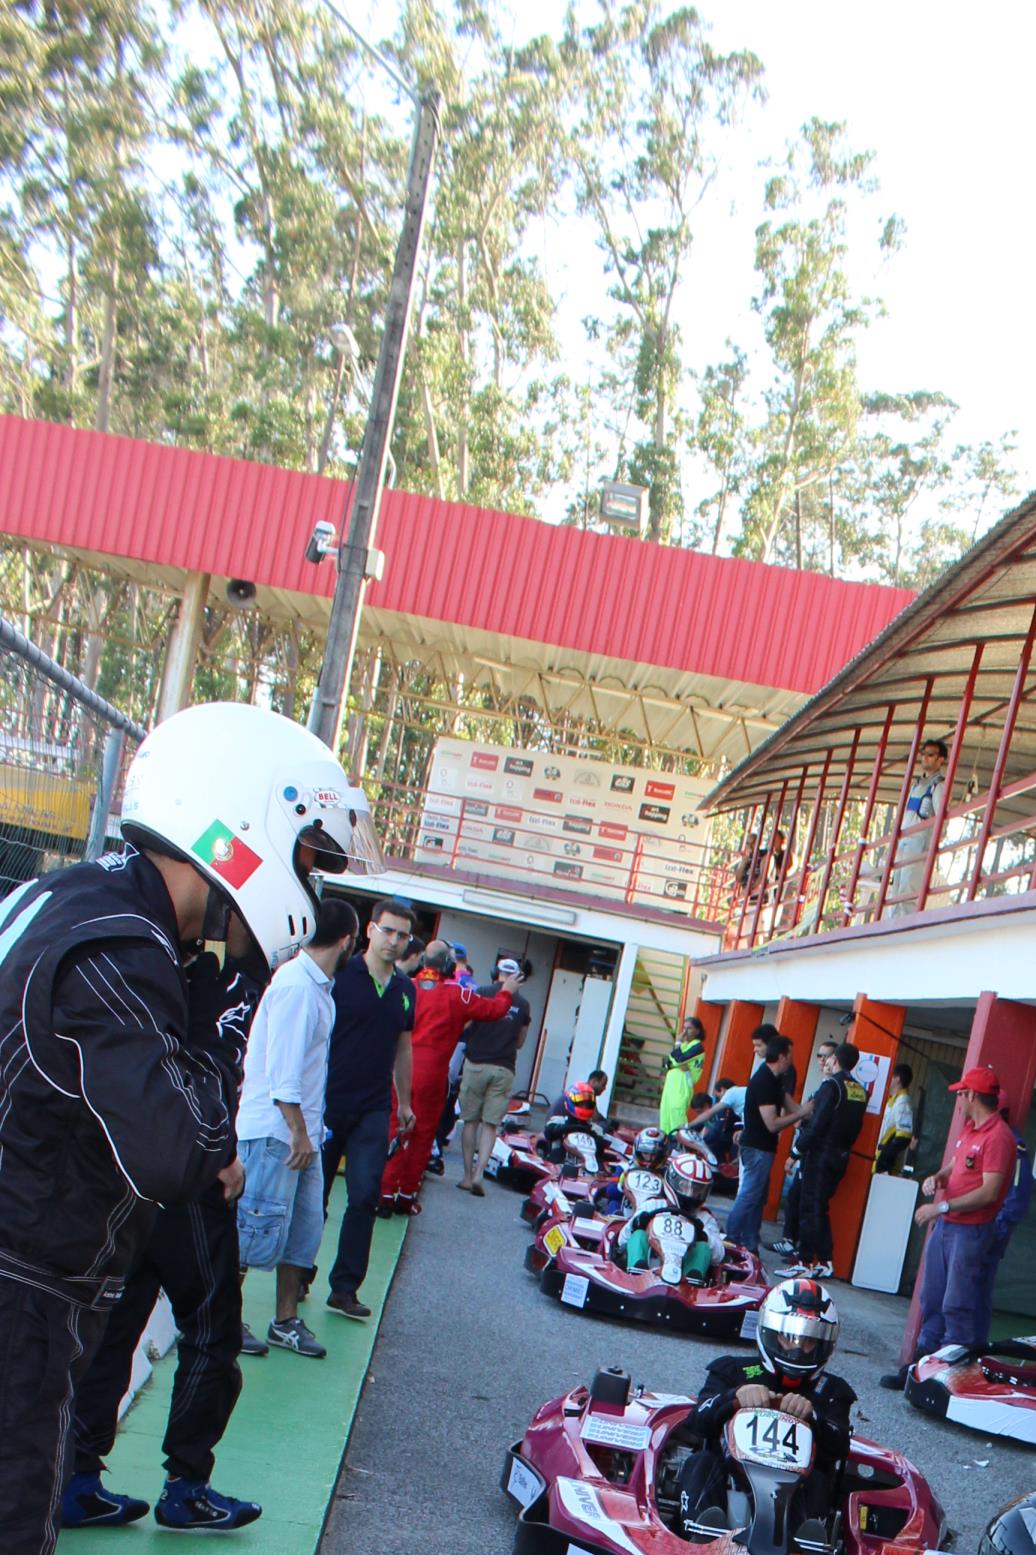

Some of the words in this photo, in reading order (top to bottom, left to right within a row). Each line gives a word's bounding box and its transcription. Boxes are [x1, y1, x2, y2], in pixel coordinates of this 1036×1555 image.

[318, 793, 338, 801] BELL
[636, 1174, 660, 1191] 123
[663, 1218, 683, 1236] 88
[746, 1415, 800, 1456] 144
